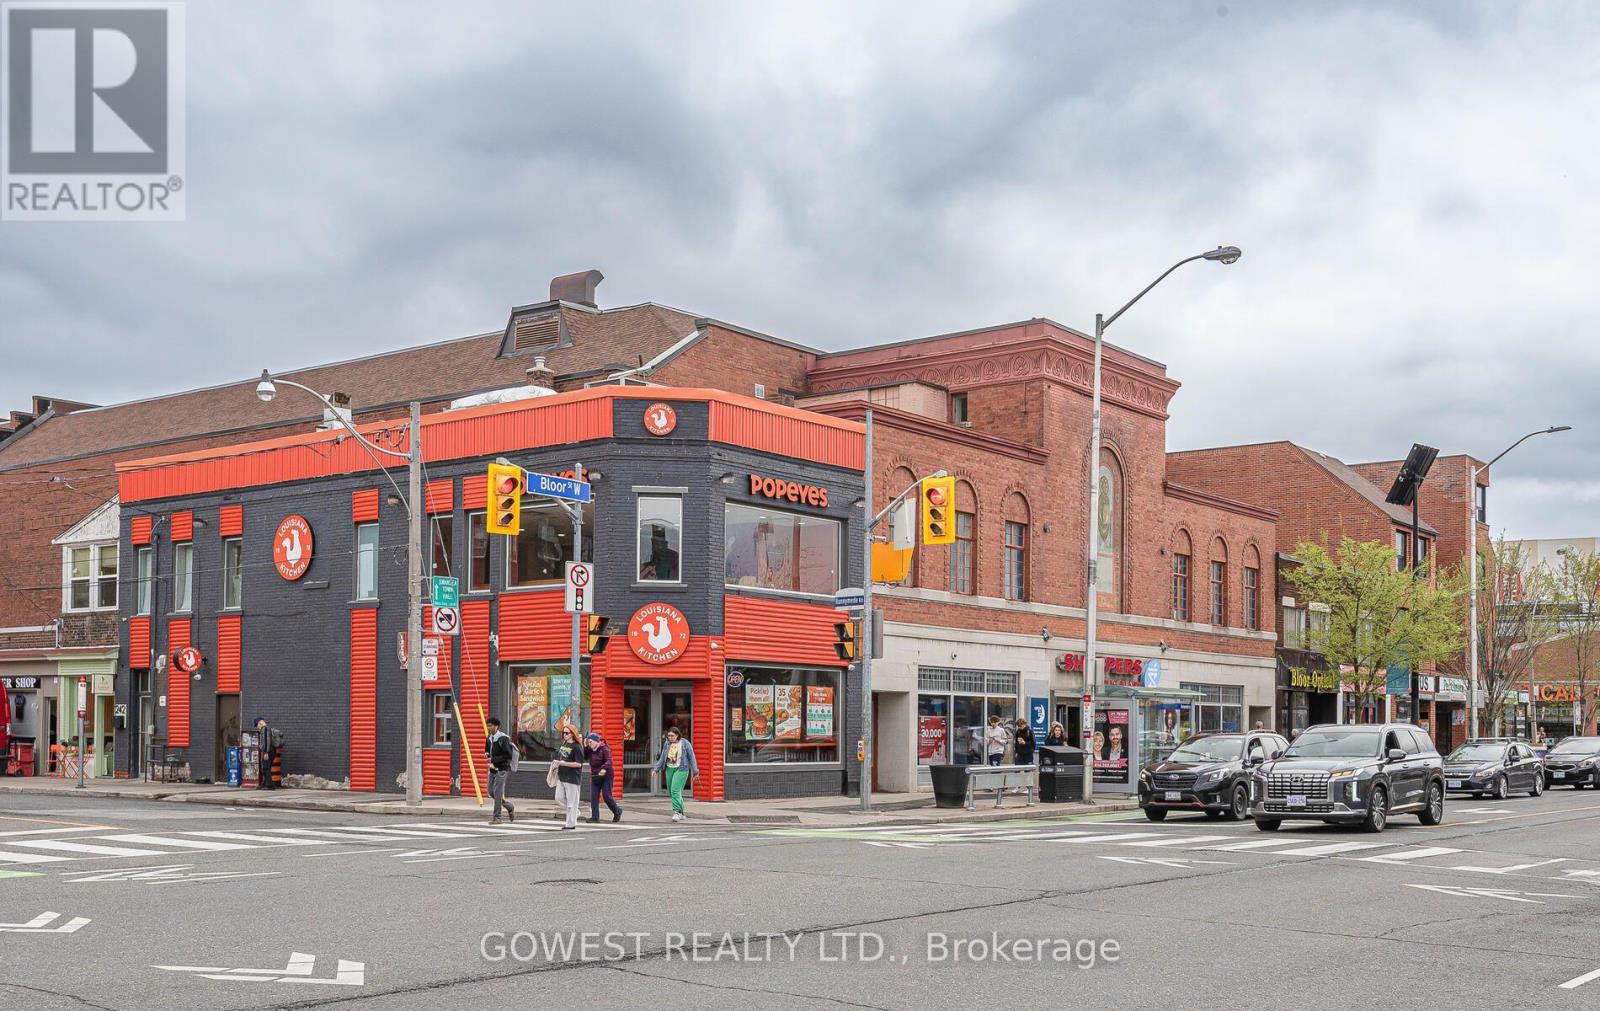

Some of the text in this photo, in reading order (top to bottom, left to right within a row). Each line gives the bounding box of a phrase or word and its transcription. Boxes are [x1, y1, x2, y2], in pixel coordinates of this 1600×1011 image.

[541, 477, 566, 492] Bloor
[573, 484, 581, 496] W
[279, 519, 307, 537] LOUISIANA
[280, 562, 305, 576] KITCHEN
[636, 606, 681, 624] LOUISIANA
[638, 647, 678, 661] KITCHEN
[15, 677, 37, 688] SHOP
[115, 704, 127, 714] 242
[921, 728, 942, 738] 30,000
